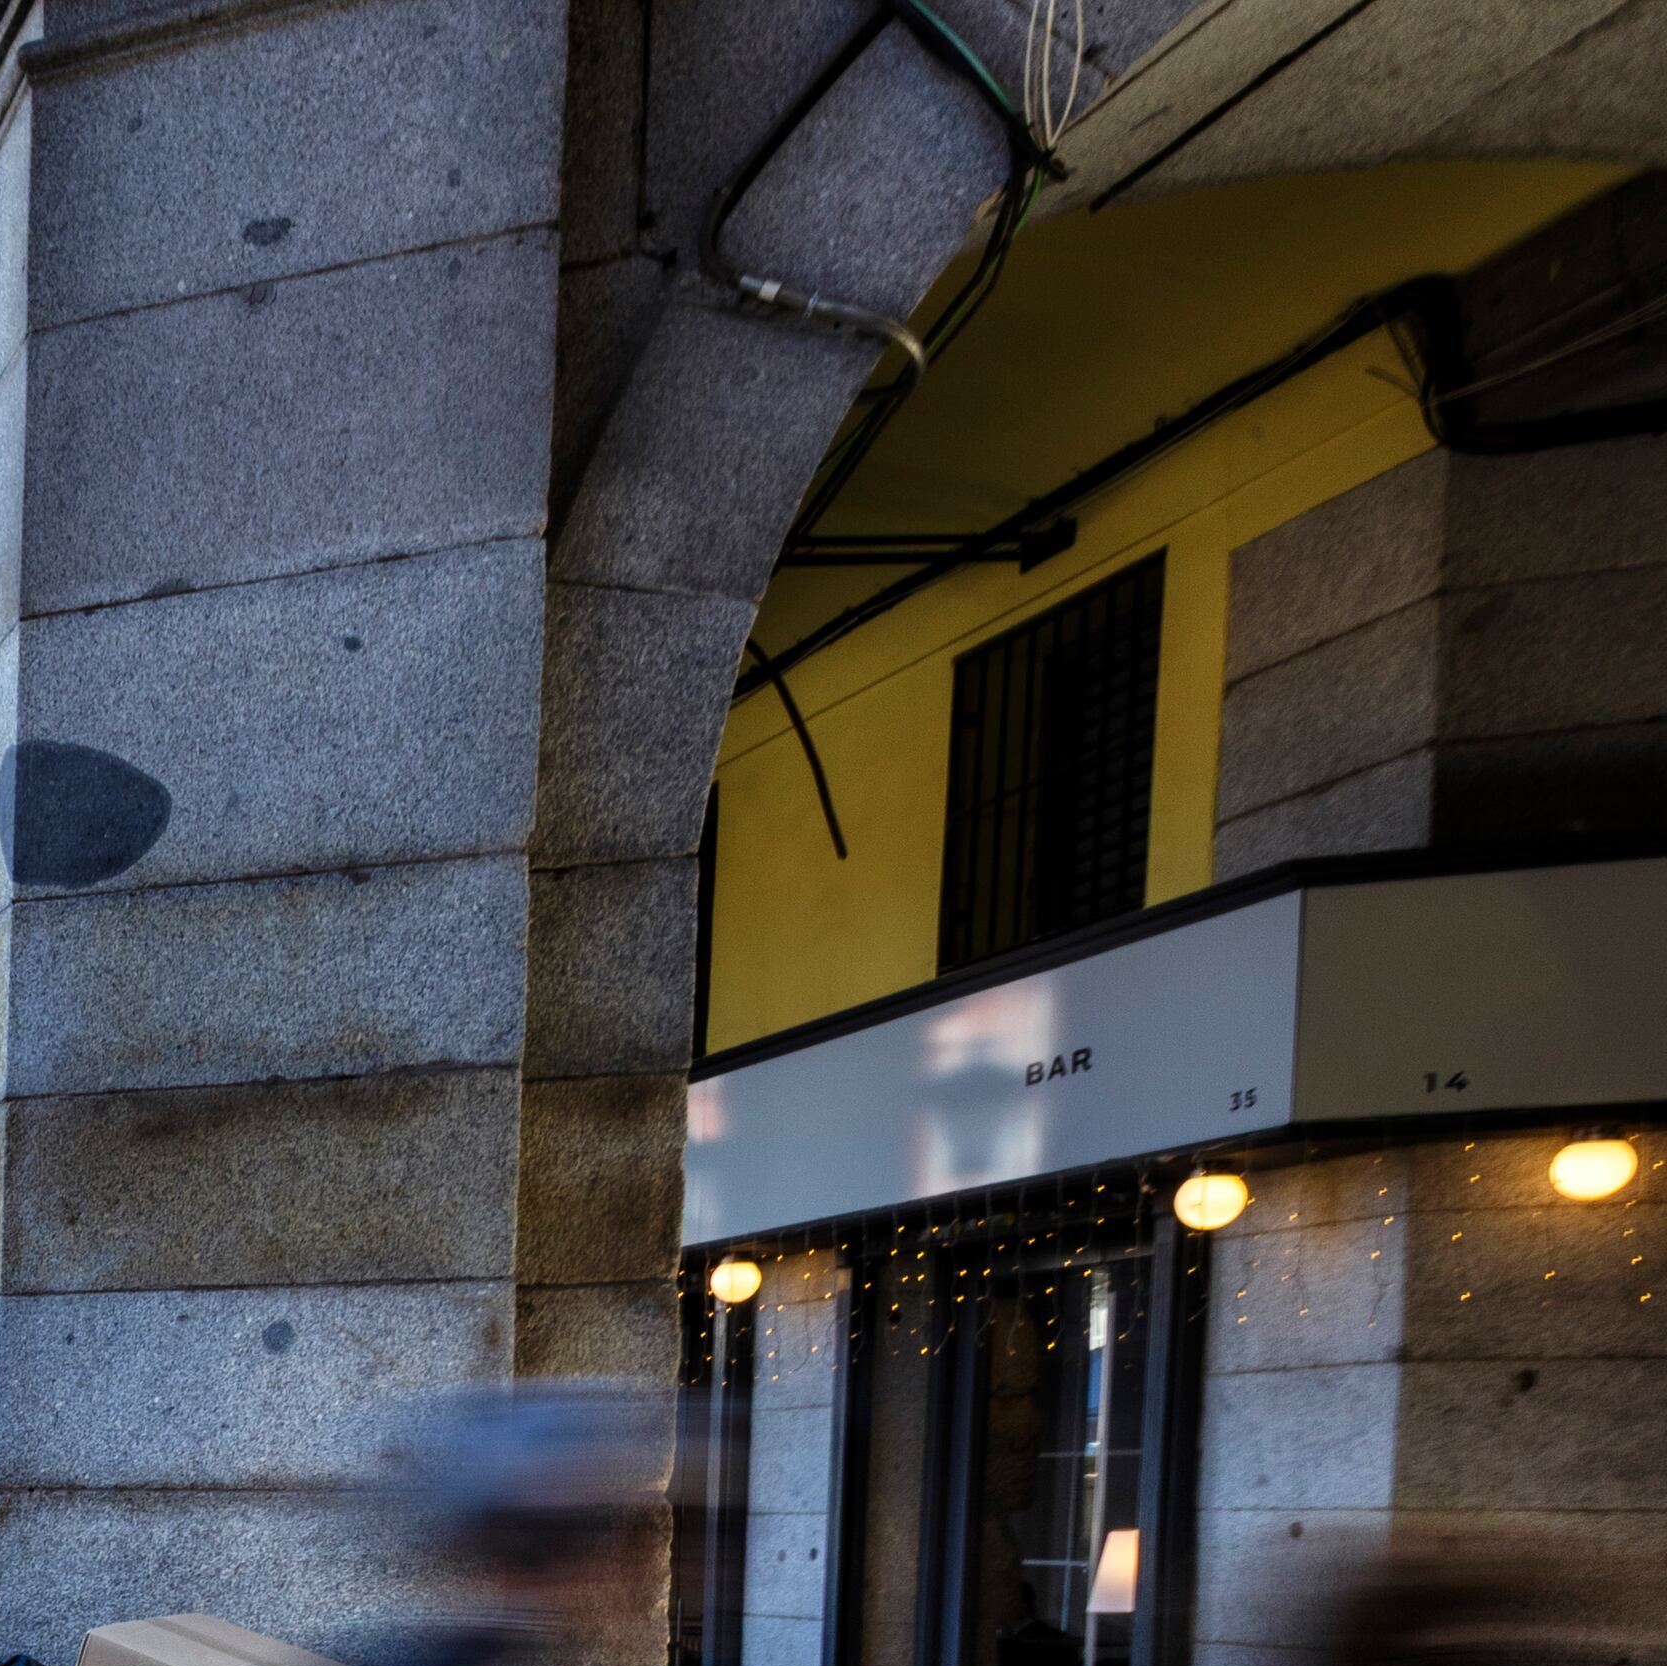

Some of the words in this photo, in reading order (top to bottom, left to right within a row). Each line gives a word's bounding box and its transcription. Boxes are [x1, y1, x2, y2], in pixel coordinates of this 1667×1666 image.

[1025, 1047, 1092, 1086] BAR
[1423, 1070, 1470, 1094] 14
[1228, 1087, 1258, 1112] 35
